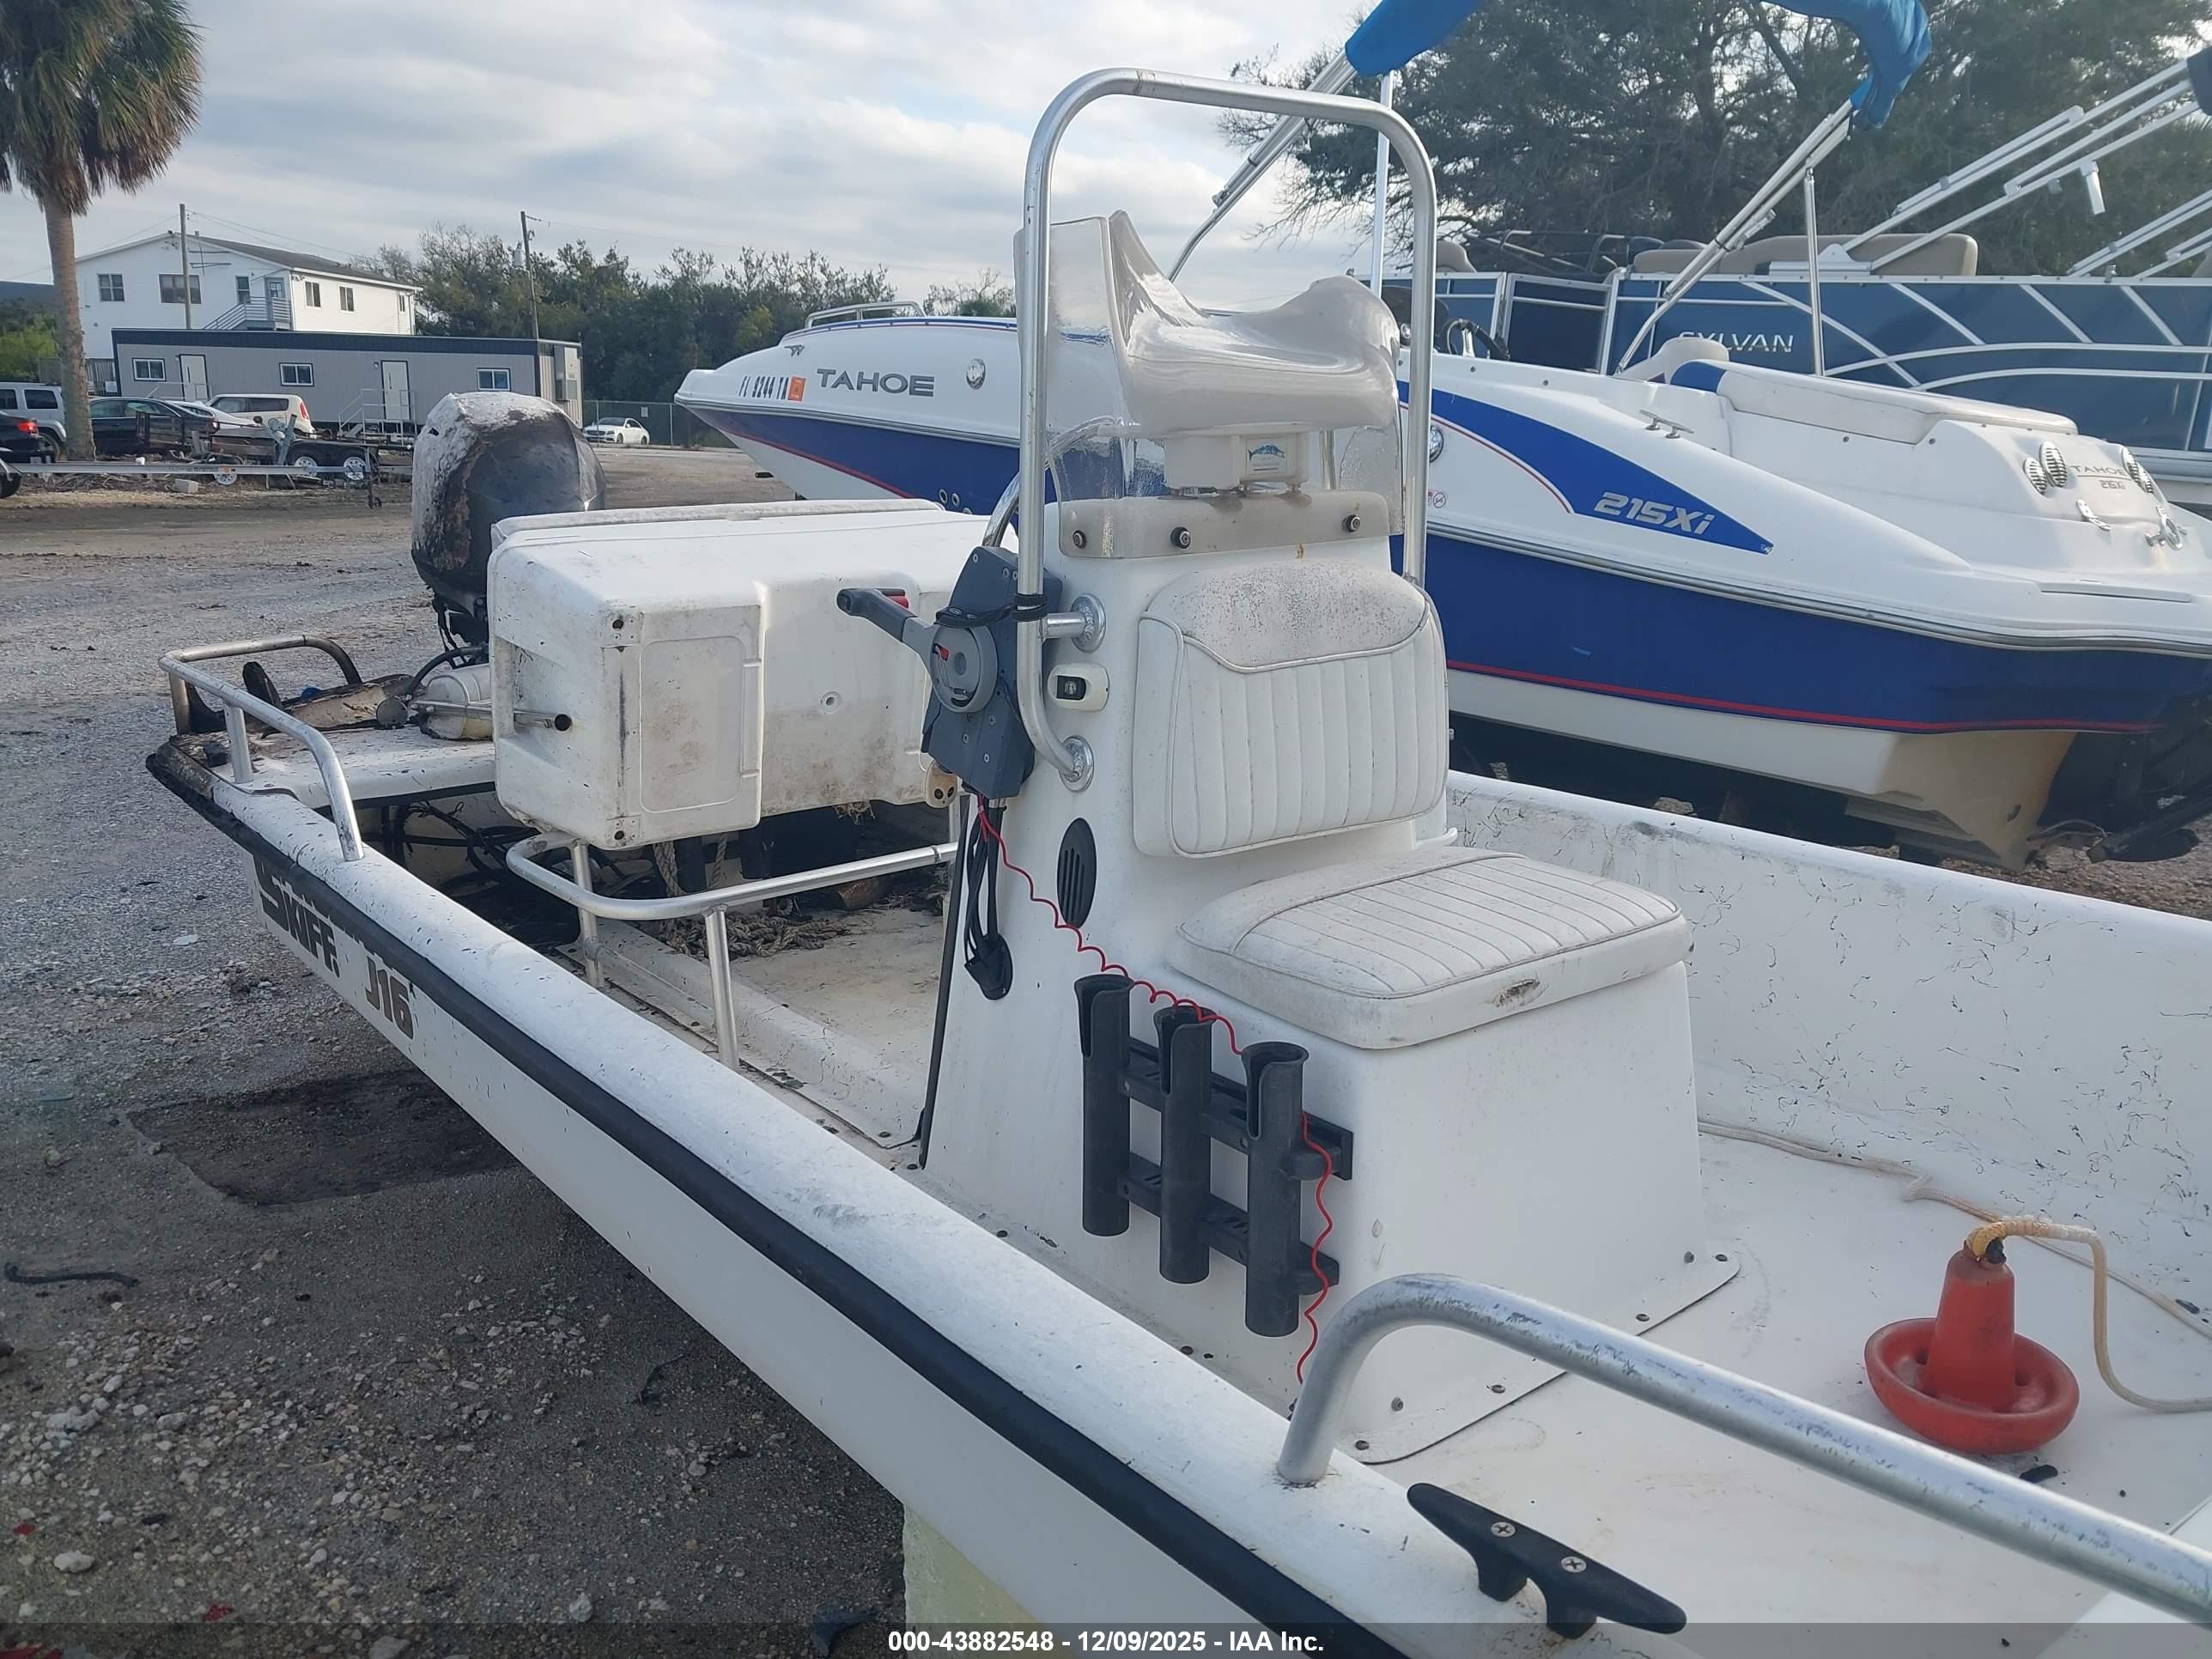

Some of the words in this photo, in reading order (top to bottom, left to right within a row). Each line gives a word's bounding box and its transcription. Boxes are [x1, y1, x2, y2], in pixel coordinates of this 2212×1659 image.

[817, 368, 934, 397] TAHOE
[1594, 491, 1715, 534] 215Xi
[364, 955, 414, 1040] J16
